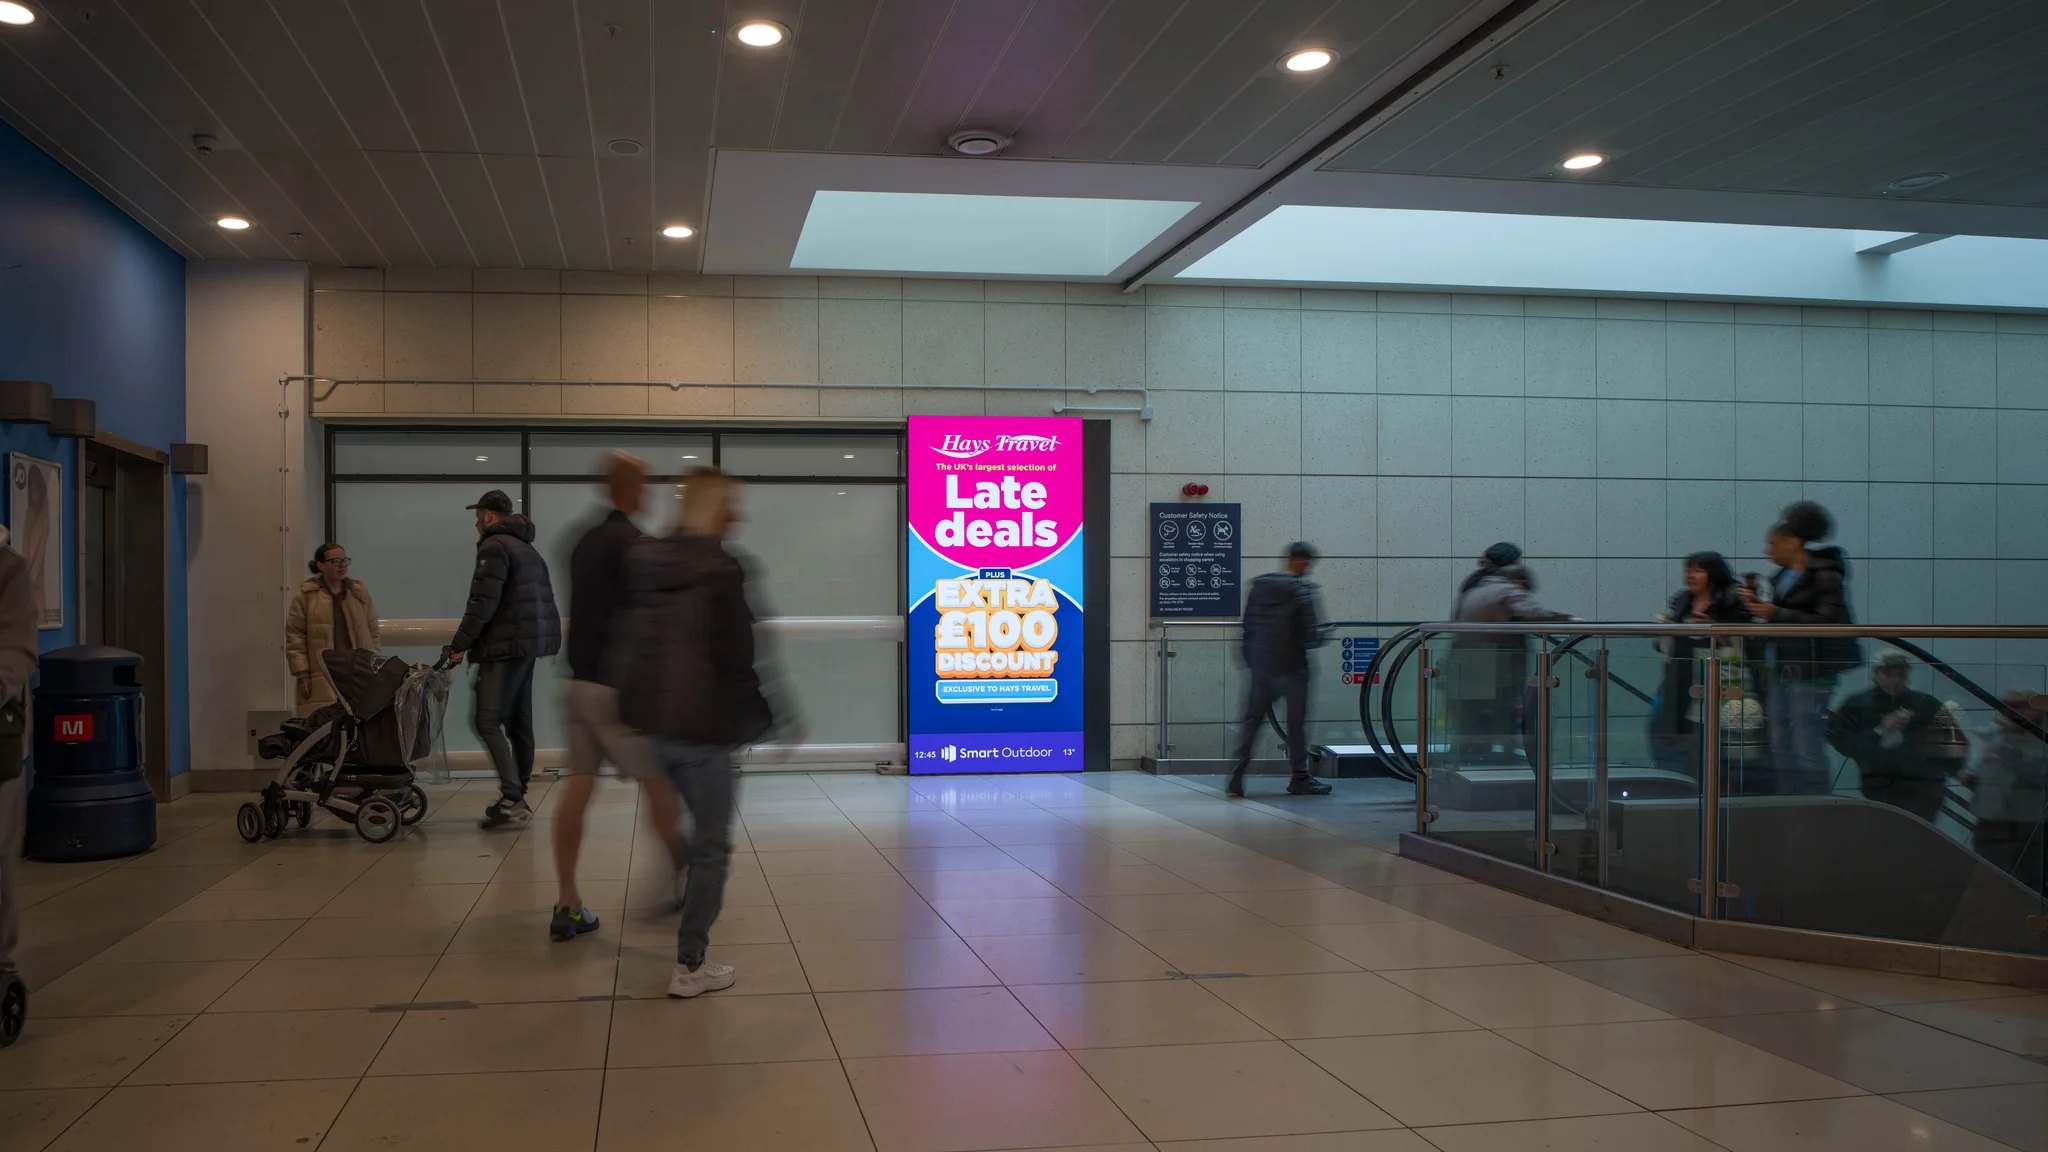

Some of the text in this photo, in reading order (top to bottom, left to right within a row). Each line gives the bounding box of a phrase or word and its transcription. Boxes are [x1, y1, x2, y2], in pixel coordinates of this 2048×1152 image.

[941, 434, 1057, 455] Hays Travel
[936, 463, 1057, 472] The UK's largest selection of
[946, 474, 1048, 510] Late
[1189, 512, 1208, 520] Safety
[935, 511, 1058, 548] deals
[985, 571, 1006, 579] PLUS
[937, 579, 1057, 609] EXTRA
[937, 610, 1056, 649] £100
[937, 651, 1057, 673] DISCOUNT
[943, 685, 986, 693] EXCLUSIVE
[987, 685, 998, 693] TO
[999, 685, 1020, 693] HAYS
[62, 720, 83, 736] M
[914, 750, 936, 759] 12:45
[959, 747, 999, 758] Smart
[1001, 746, 1053, 758] Outdoor
